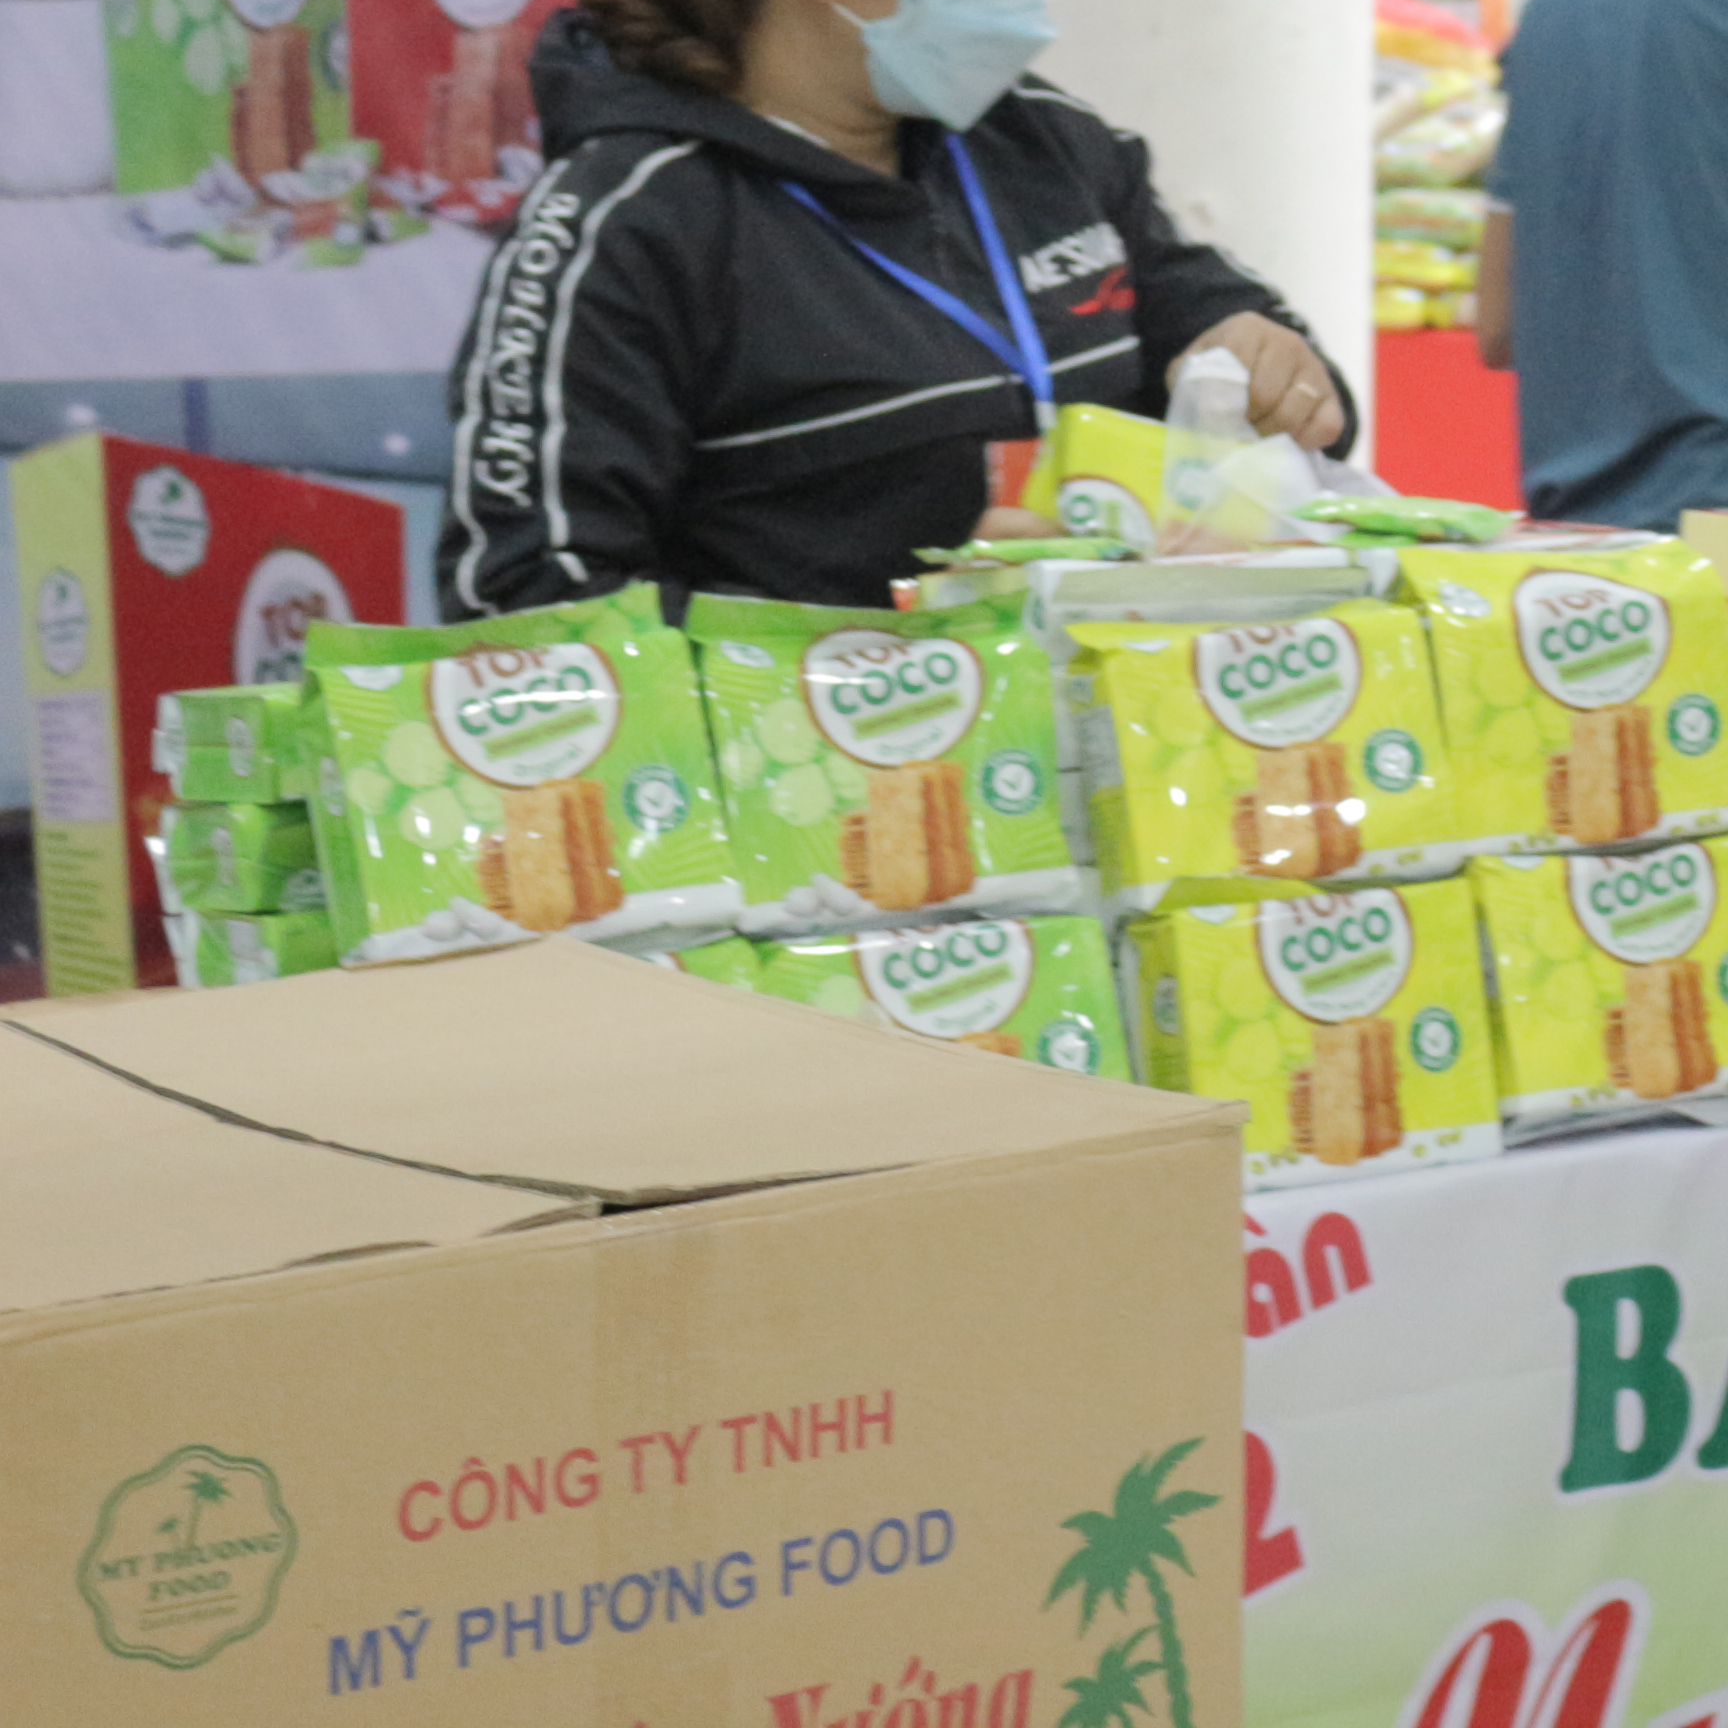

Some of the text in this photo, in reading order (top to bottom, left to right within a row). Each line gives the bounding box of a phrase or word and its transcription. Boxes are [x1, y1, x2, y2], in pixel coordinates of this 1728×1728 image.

[1539, 600, 1651, 662] COCO
[829, 651, 959, 715] COCO
[1218, 633, 1338, 700] COCO
[458, 665, 594, 736] COCO
[1589, 853, 1697, 916] COCO
[883, 923, 1009, 990] COCO
[1280, 907, 1393, 972] COCO
[397, 1389, 897, 1544] CÔNG TY TNHH
[325, 1506, 959, 1697] MỸ PHƯƠNG FOOD
